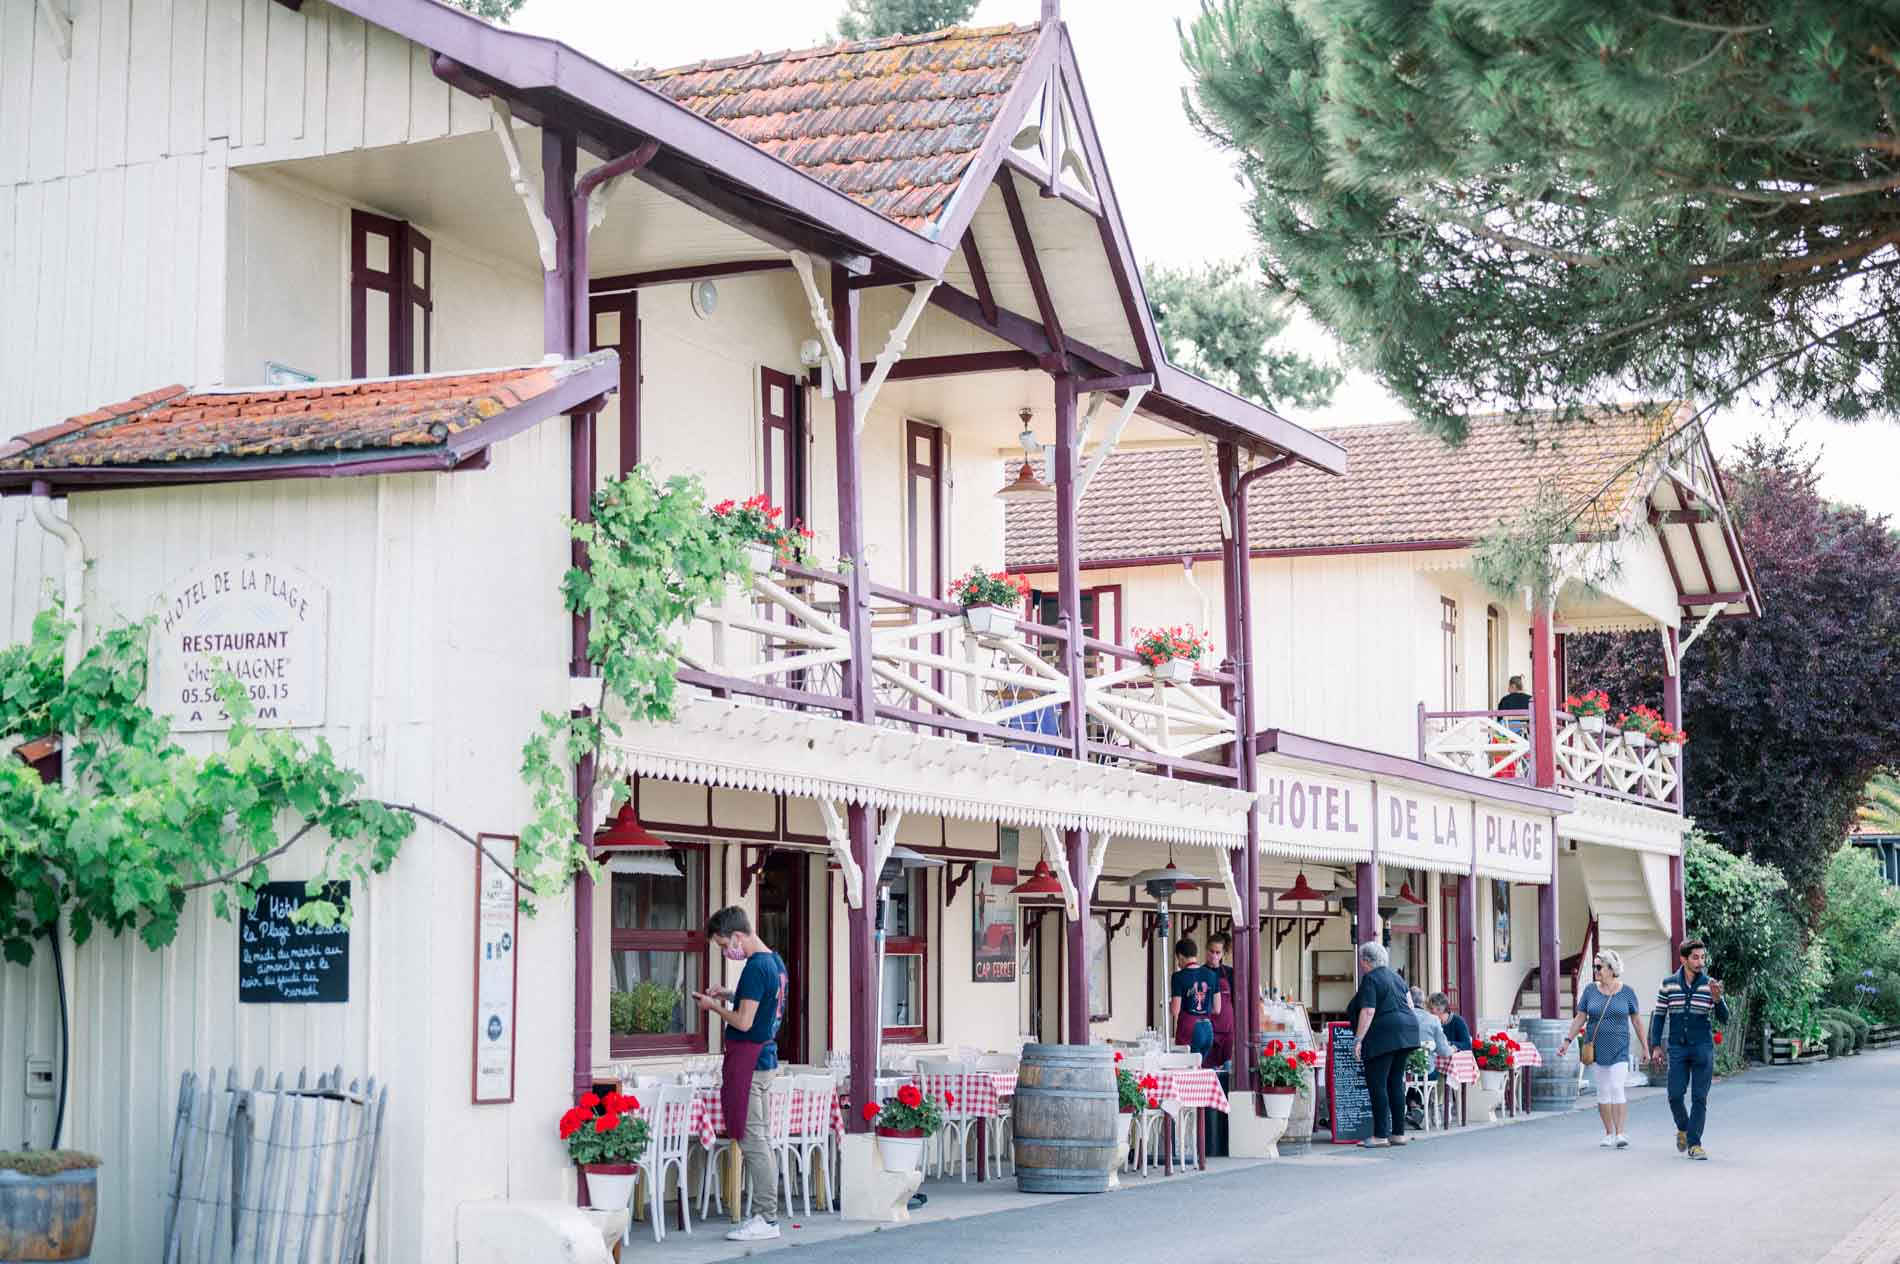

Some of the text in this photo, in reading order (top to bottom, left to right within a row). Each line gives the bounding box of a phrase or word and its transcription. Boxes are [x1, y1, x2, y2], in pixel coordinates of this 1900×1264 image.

[163, 568, 309, 634] HOTEL DE LA PLAGE
[182, 631, 289, 653] RESTAURANT
[1268, 777, 1543, 860] HOTEL DE LA PLAGE
[259, 921, 291, 945] Plage
[254, 948, 276, 961] midi
[291, 944, 322, 958] mardi
[324, 946, 344, 955] au
[975, 962, 991, 977] CAP
